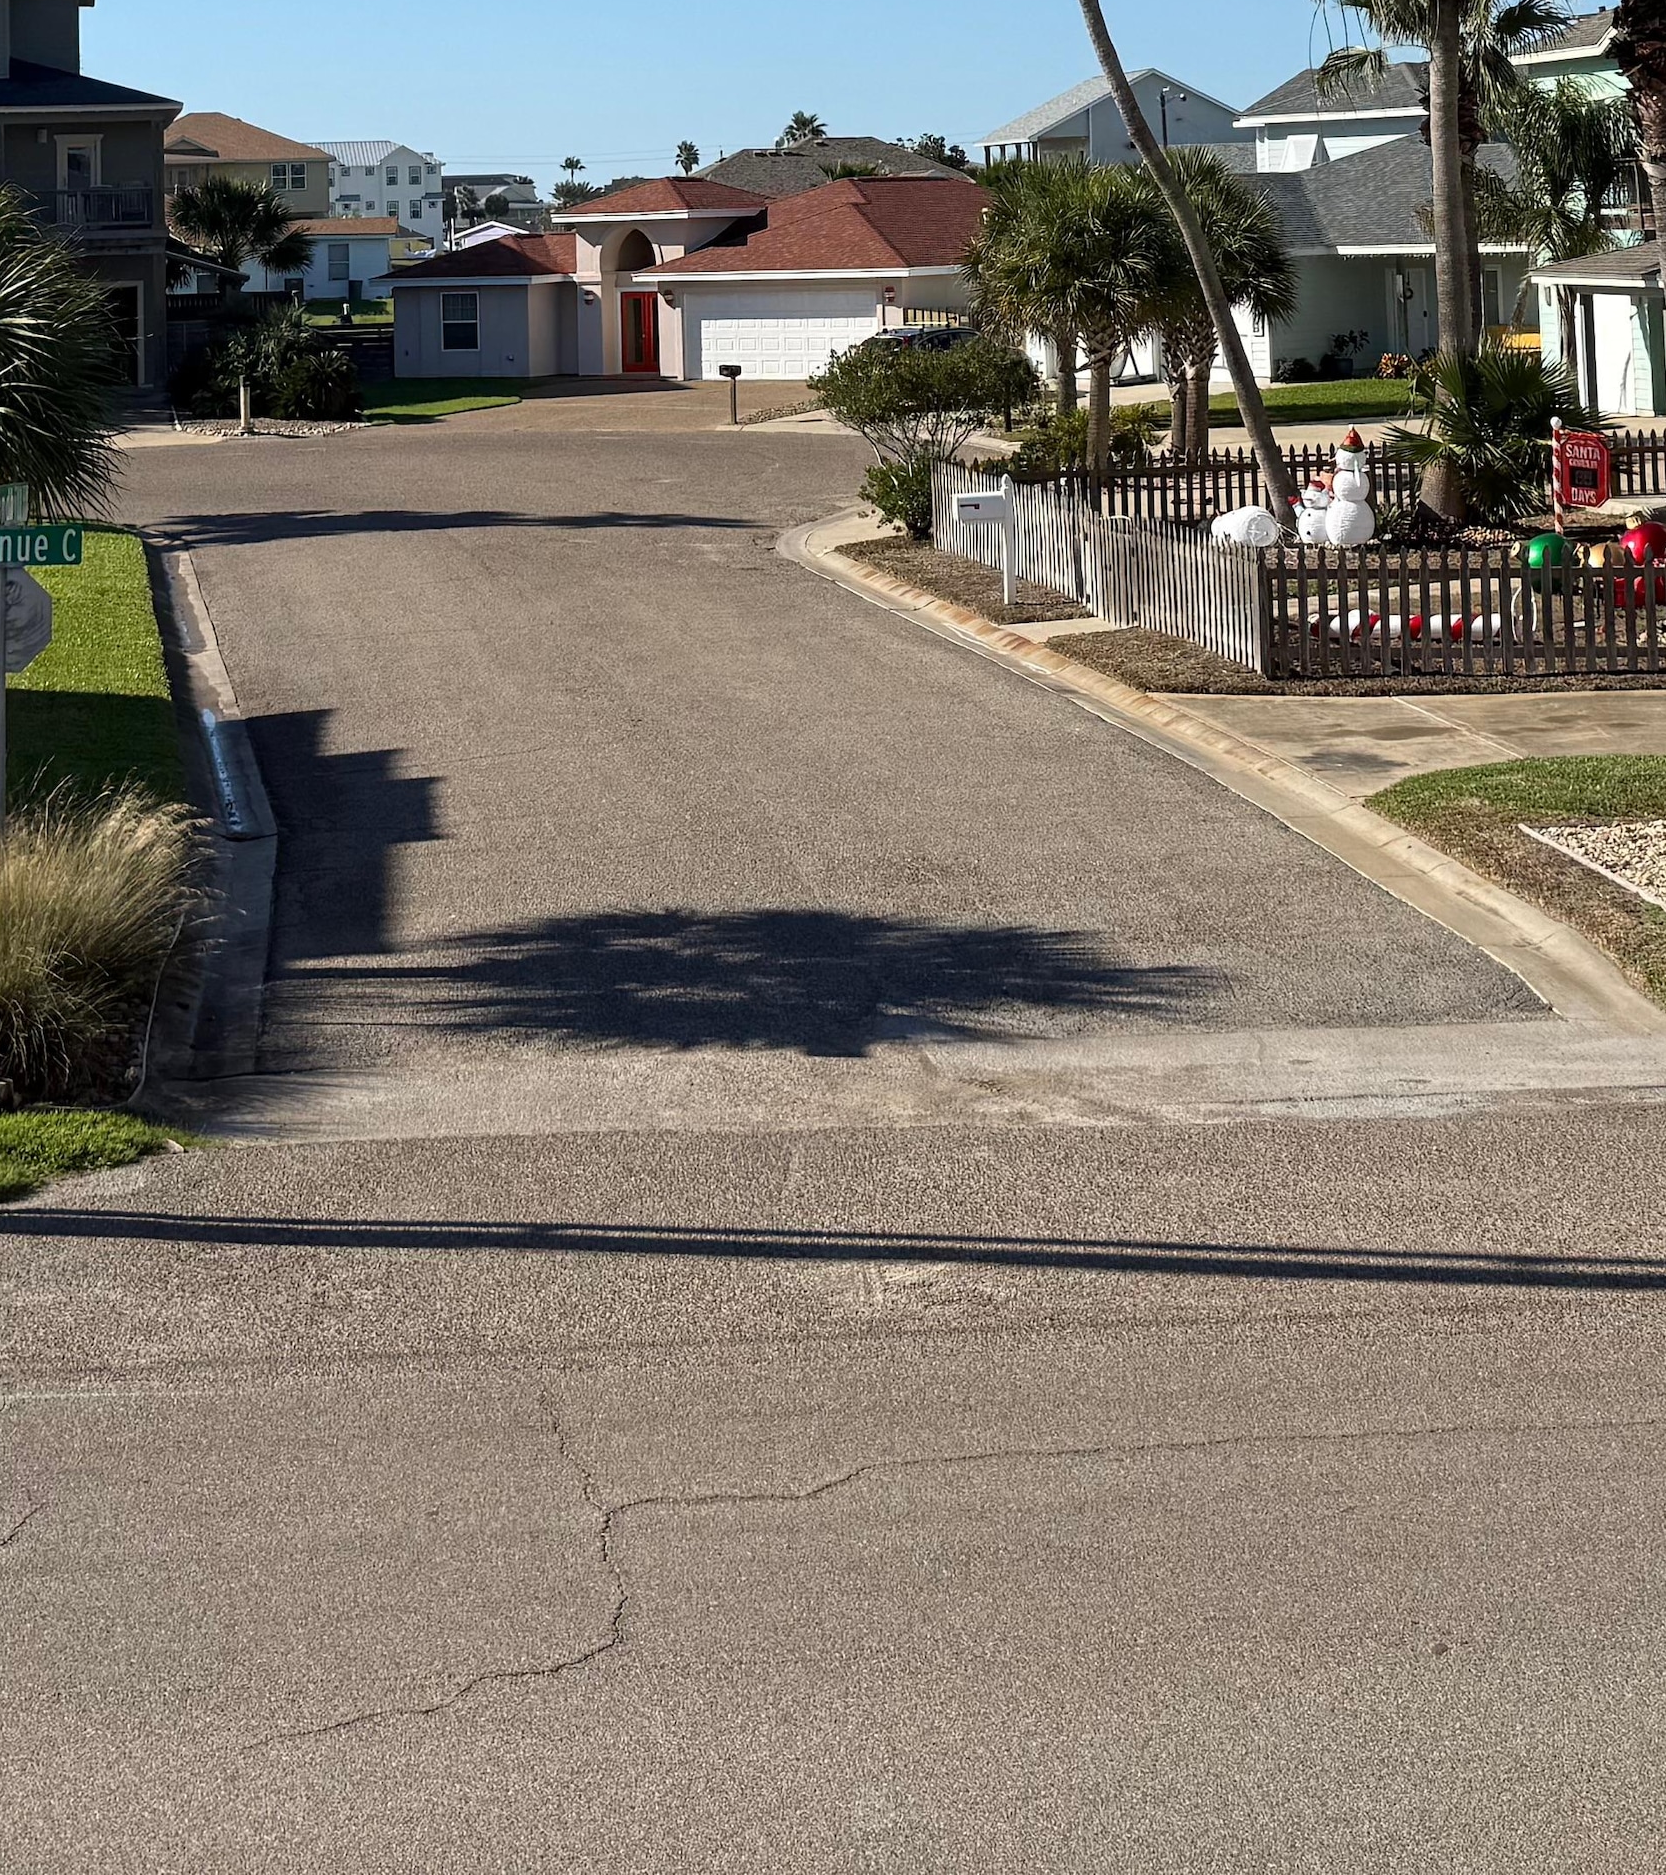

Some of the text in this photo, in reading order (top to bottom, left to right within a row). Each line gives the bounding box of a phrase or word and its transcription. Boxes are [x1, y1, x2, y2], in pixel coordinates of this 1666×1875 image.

[1565, 444, 1600, 461] SANTA
[1571, 487, 1597, 504] DAYS
[62, 528, 76, 562] C
